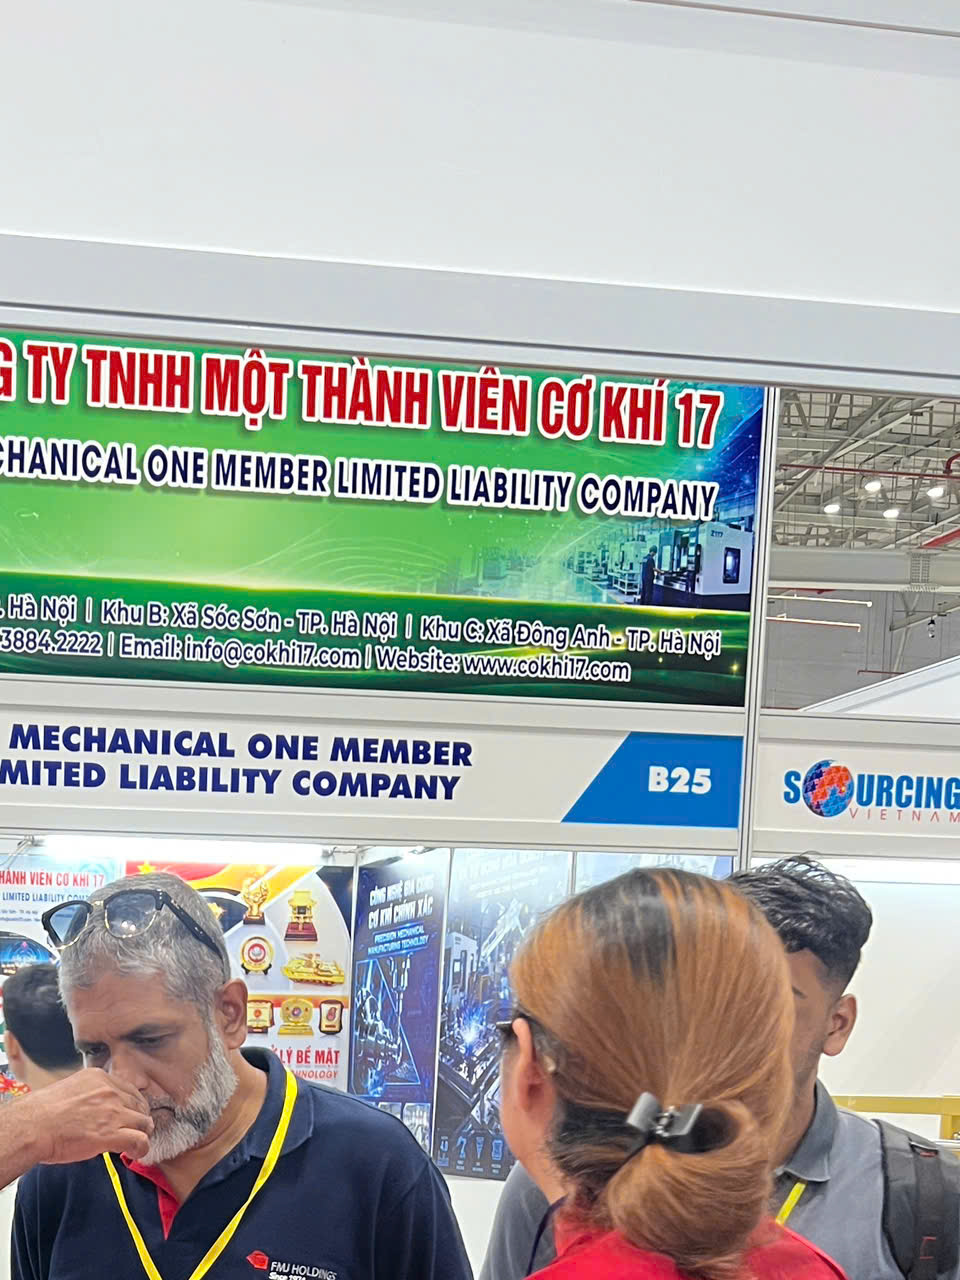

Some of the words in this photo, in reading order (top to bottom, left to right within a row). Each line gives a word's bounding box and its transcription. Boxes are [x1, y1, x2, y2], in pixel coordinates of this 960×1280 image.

[27, 344, 73, 400] TY
[86, 350, 190, 409] TNHH
[205, 348, 289, 426] MỘT
[302, 356, 428, 425] THÀNH
[442, 366, 527, 430] VIÊN
[542, 376, 594, 436] CƠ
[602, 378, 666, 442] KHÍ
[679, 392, 721, 446] 17
[148, 449, 204, 485] ONE
[215, 452, 327, 491] MEMBER
[338, 461, 438, 499] LIMITED
[451, 465, 570, 504] LIABILITY
[582, 477, 715, 518] COMPANY
[10, 595, 36, 619] Hà
[43, 597, 77, 626] Nội
[104, 601, 141, 623] Khu
[150, 605, 169, 625] B:
[173, 603, 197, 627] Xã
[204, 605, 238, 629] Sóc
[245, 608, 279, 632] Sơn
[298, 613, 326, 634] TP.
[333, 611, 358, 635] Hà
[364, 614, 397, 643] Nội
[423, 618, 460, 641] Khu
[465, 623, 484, 641] C:
[488, 622, 511, 643] Xã
[517, 622, 567, 649] Đông
[573, 626, 610, 648] Anh
[628, 630, 656, 652] TP.
[661, 629, 686, 653] Hà
[691, 632, 721, 659] Nội
[121, 635, 182, 659] Email:
[186, 639, 360, 668] info@cokhi17.com
[376, 646, 460, 672] Website:
[465, 653, 630, 682] www.cokhi17.com
[9, 723, 234, 758] MECHANICAL
[248, 733, 319, 761] ONE
[330, 736, 473, 767] MEMBER
[120, 763, 282, 795] LIABILITY
[292, 769, 461, 801] COMPANY
[648, 765, 712, 796] B25
[30, 867, 52, 886] VIÊN
[56, 872, 69, 887] CƠ
[72, 869, 88, 888] KHÍ
[93, 874, 104, 888] 17
[271, 1260, 290, 1275] FMJ
